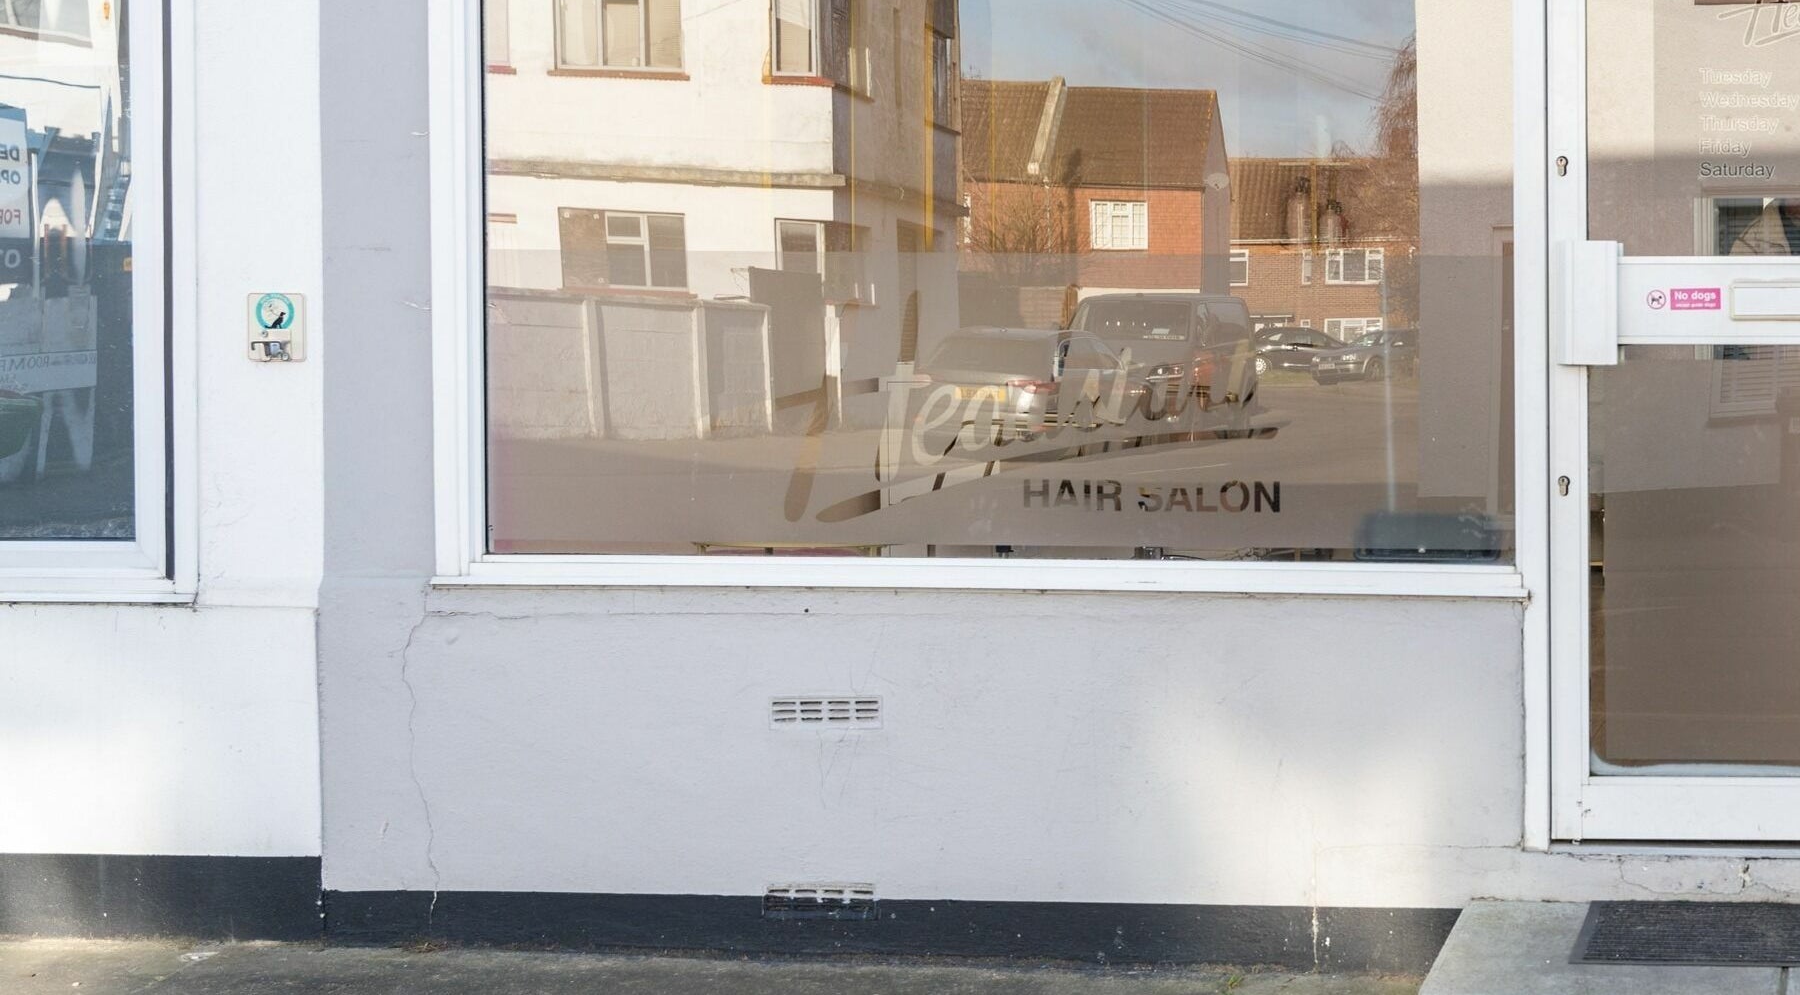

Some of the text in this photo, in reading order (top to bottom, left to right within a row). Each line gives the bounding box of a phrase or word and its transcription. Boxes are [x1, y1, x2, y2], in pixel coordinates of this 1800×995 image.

[1700, 67, 1773, 88] Tuesday
[1700, 91, 1800, 111] Wednesday
[1700, 115, 1780, 133] Thursday
[1700, 139, 1751, 157] Friday
[1700, 162, 1775, 180] Saturday
[1674, 290, 1717, 302] No dogs
[1022, 478, 1281, 514] HAIR SALON
